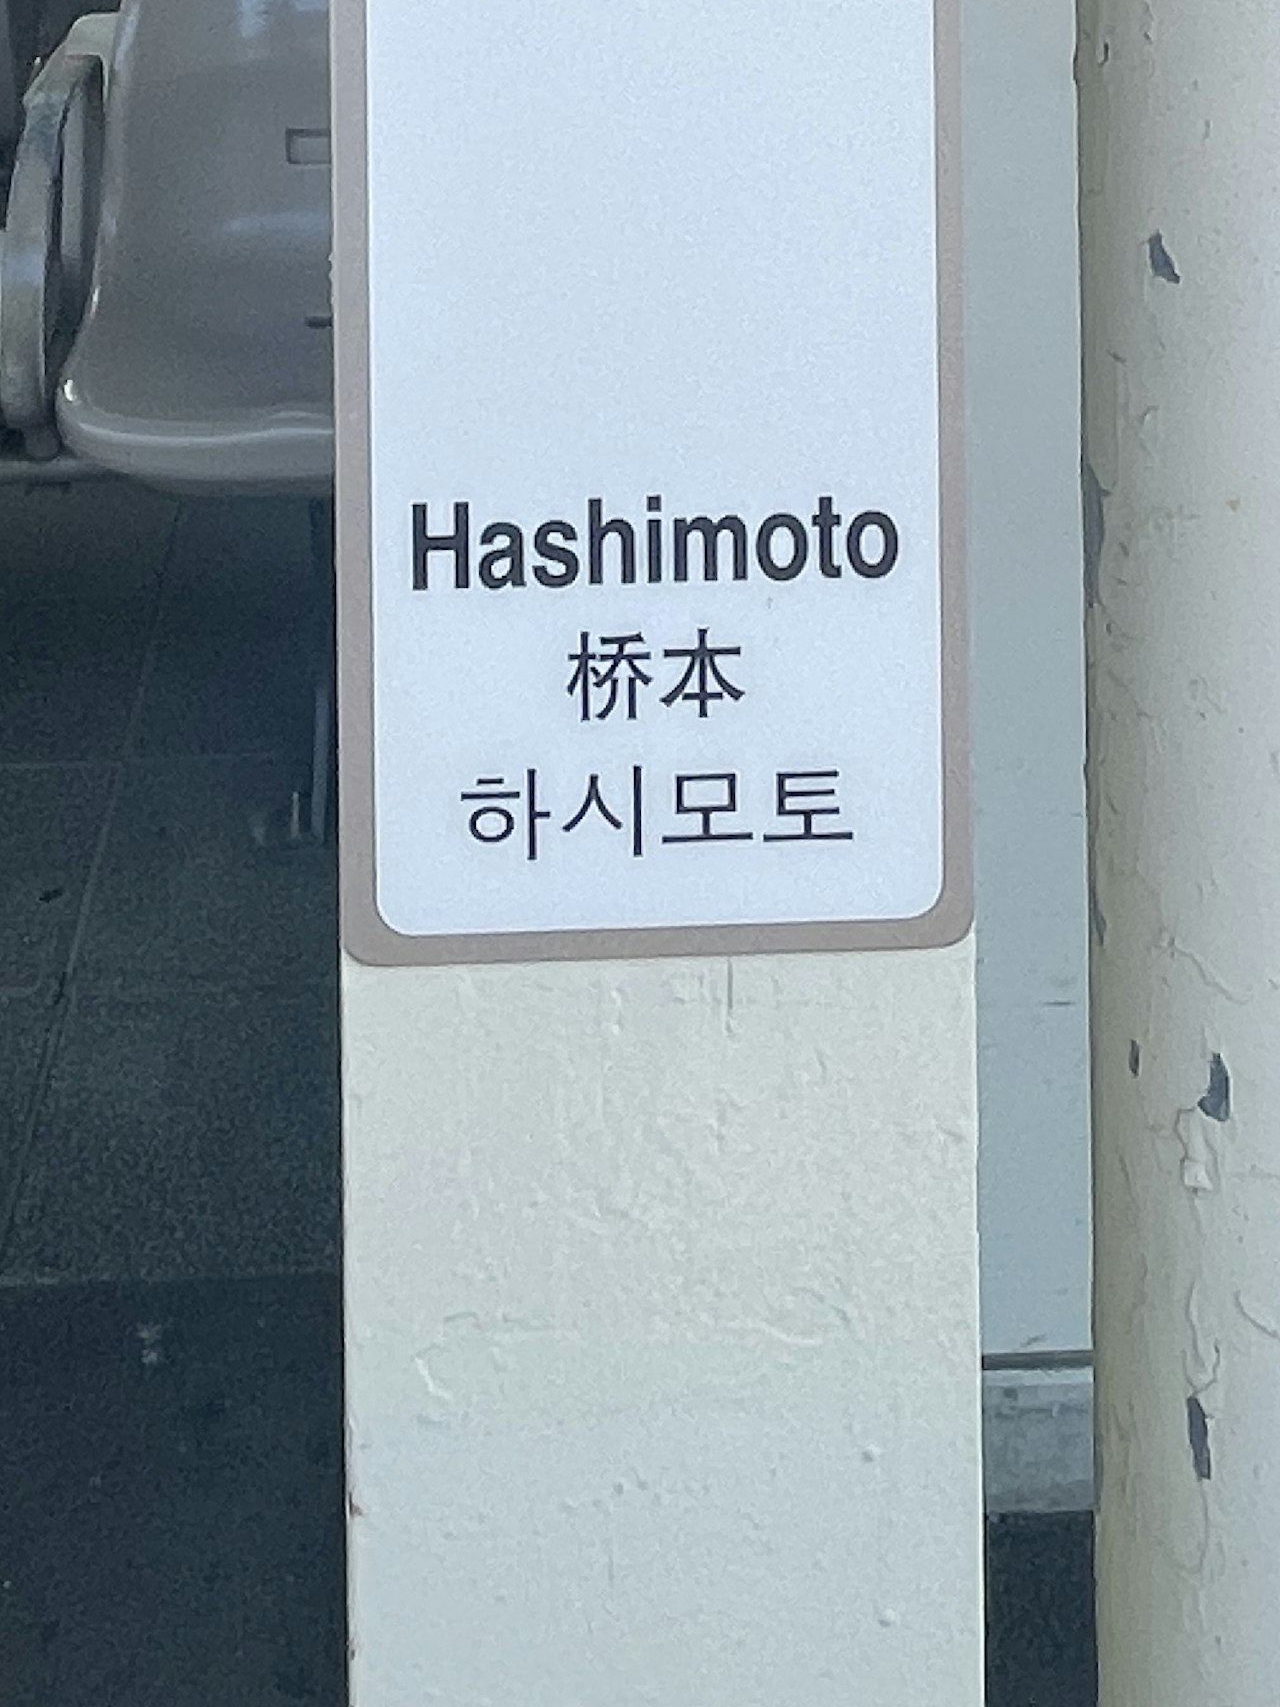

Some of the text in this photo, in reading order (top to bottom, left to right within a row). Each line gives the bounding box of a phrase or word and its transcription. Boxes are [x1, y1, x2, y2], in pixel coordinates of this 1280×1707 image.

[412, 494, 899, 591] Hashimoto
[567, 628, 746, 722] 桥本
[460, 765, 854, 861] 하시모토
